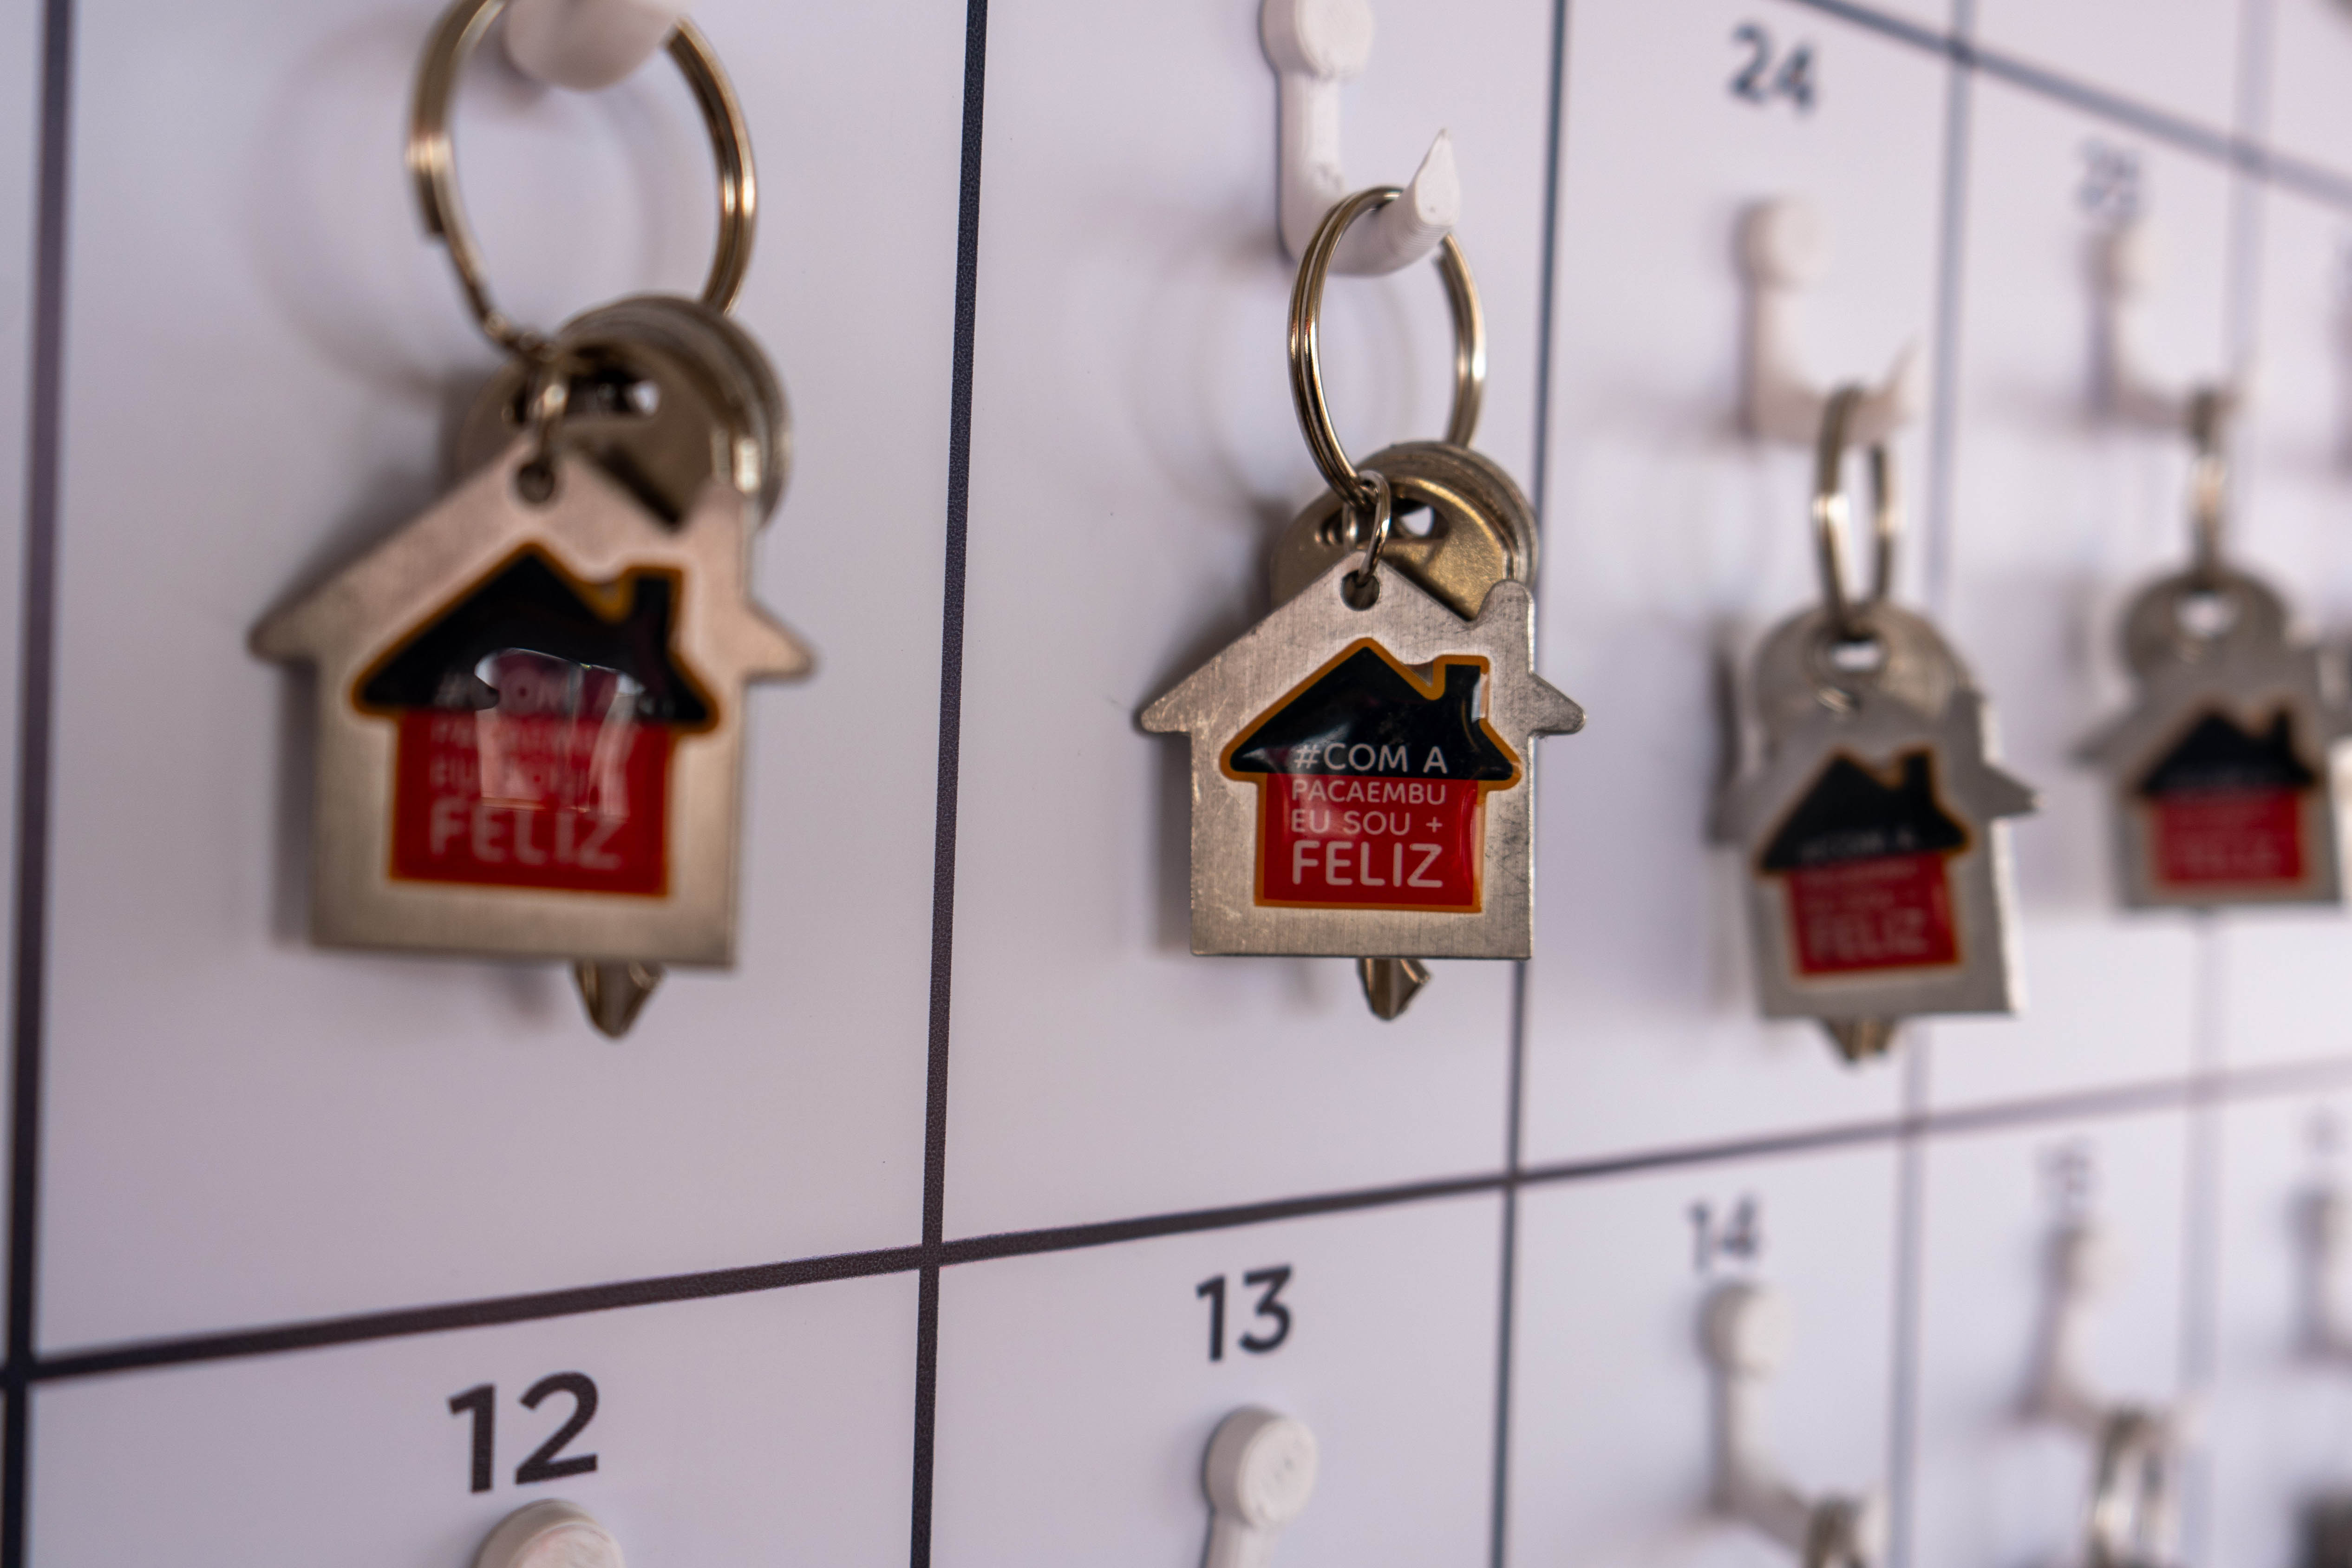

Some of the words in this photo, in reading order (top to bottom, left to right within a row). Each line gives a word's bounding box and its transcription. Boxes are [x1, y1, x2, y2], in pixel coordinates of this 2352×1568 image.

[1729, 21, 1816, 116] 24
[1291, 780, 1446, 805] PACAEMBU
[1294, 743, 1408, 772] #COM
[1424, 746, 1448, 774] A
[430, 797, 623, 870] FELIZ
[1291, 810, 1330, 834] EU
[1343, 811, 1410, 836] SOU
[1292, 842, 1443, 888] FELIZ
[1687, 1194, 1763, 1274] 14
[1195, 1265, 1294, 1362] 13
[448, 1372, 601, 1493] 12
